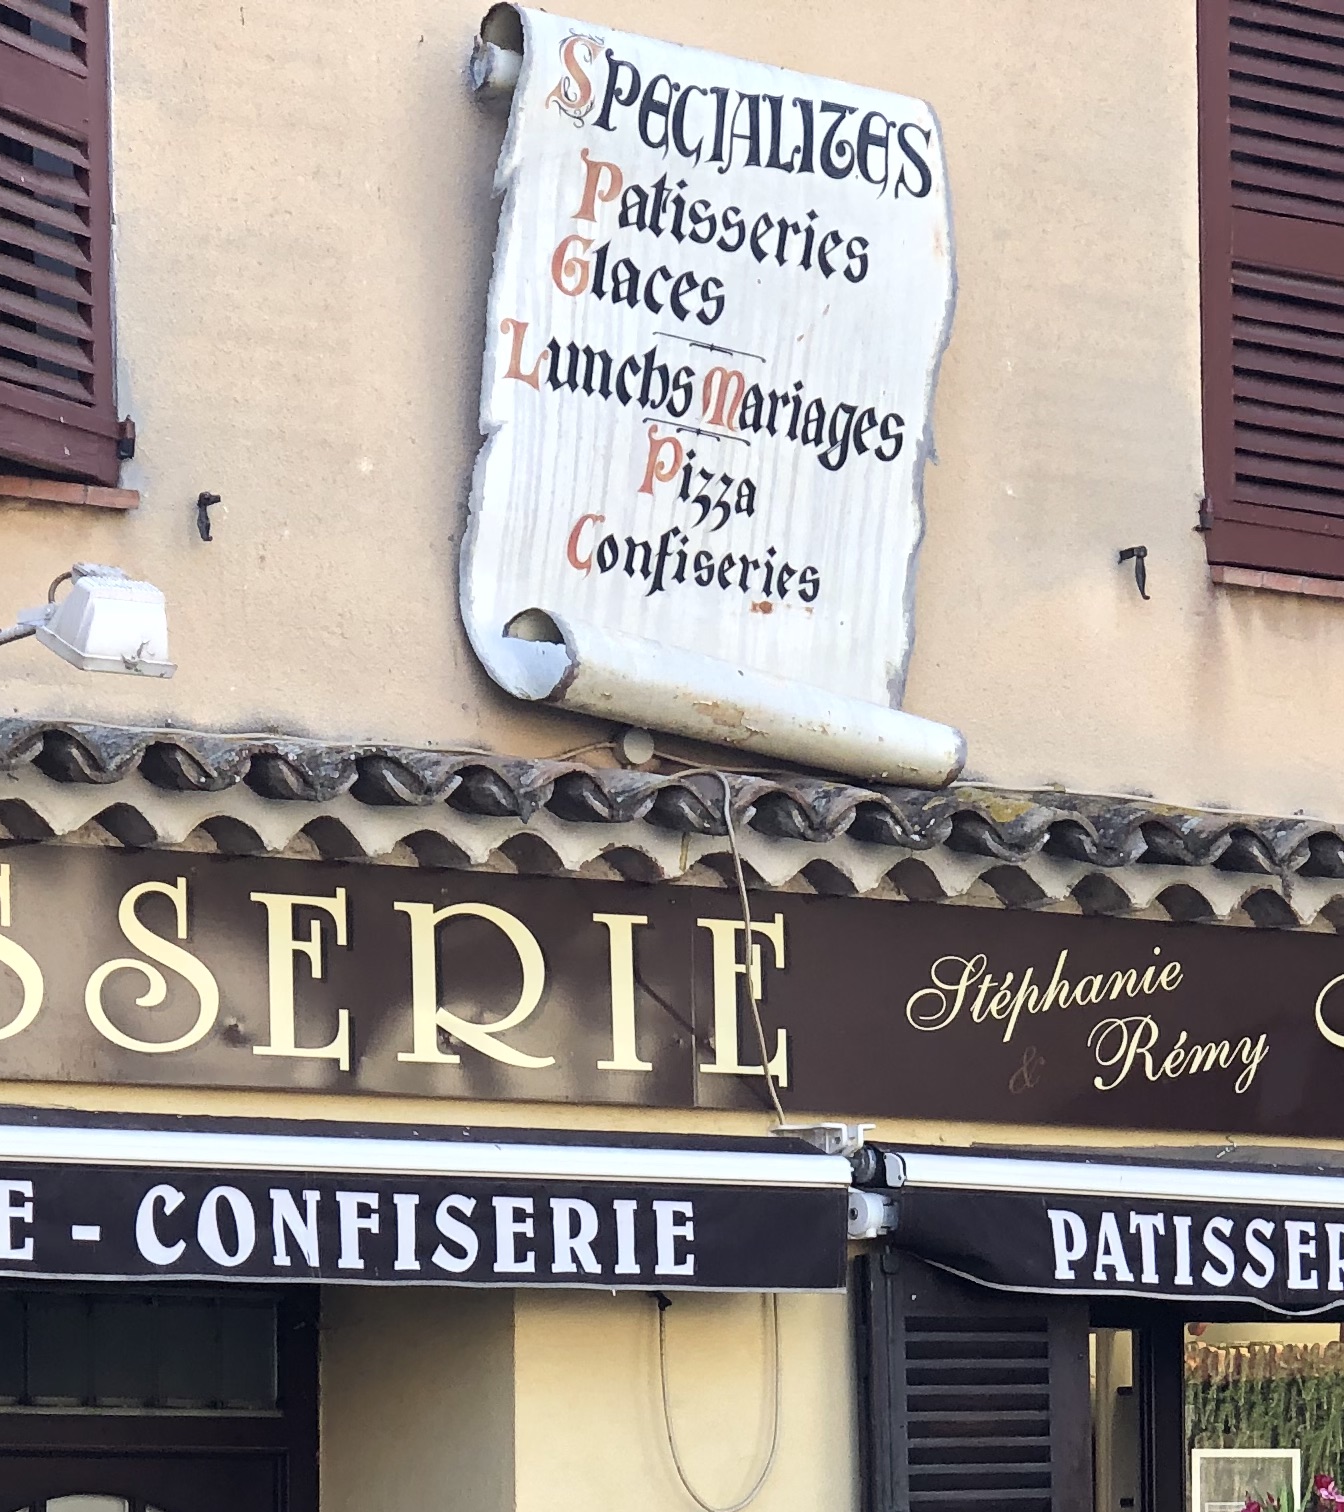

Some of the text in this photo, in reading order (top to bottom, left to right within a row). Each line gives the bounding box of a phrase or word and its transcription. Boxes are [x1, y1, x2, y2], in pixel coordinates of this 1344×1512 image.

[545, 28, 933, 200] SPECIALITES
[571, 147, 869, 283] Patisseries
[550, 234, 726, 326] Glaces
[500, 317, 906, 472] Lunchs Mariages
[637, 423, 757, 532] Pizza
[566, 513, 821, 603] Confiseries
[905, 946, 1184, 1043] Stéphanie
[1086, 1014, 1270, 1094] Rémy
[135, 1183, 697, 1278] CONFISERIE
